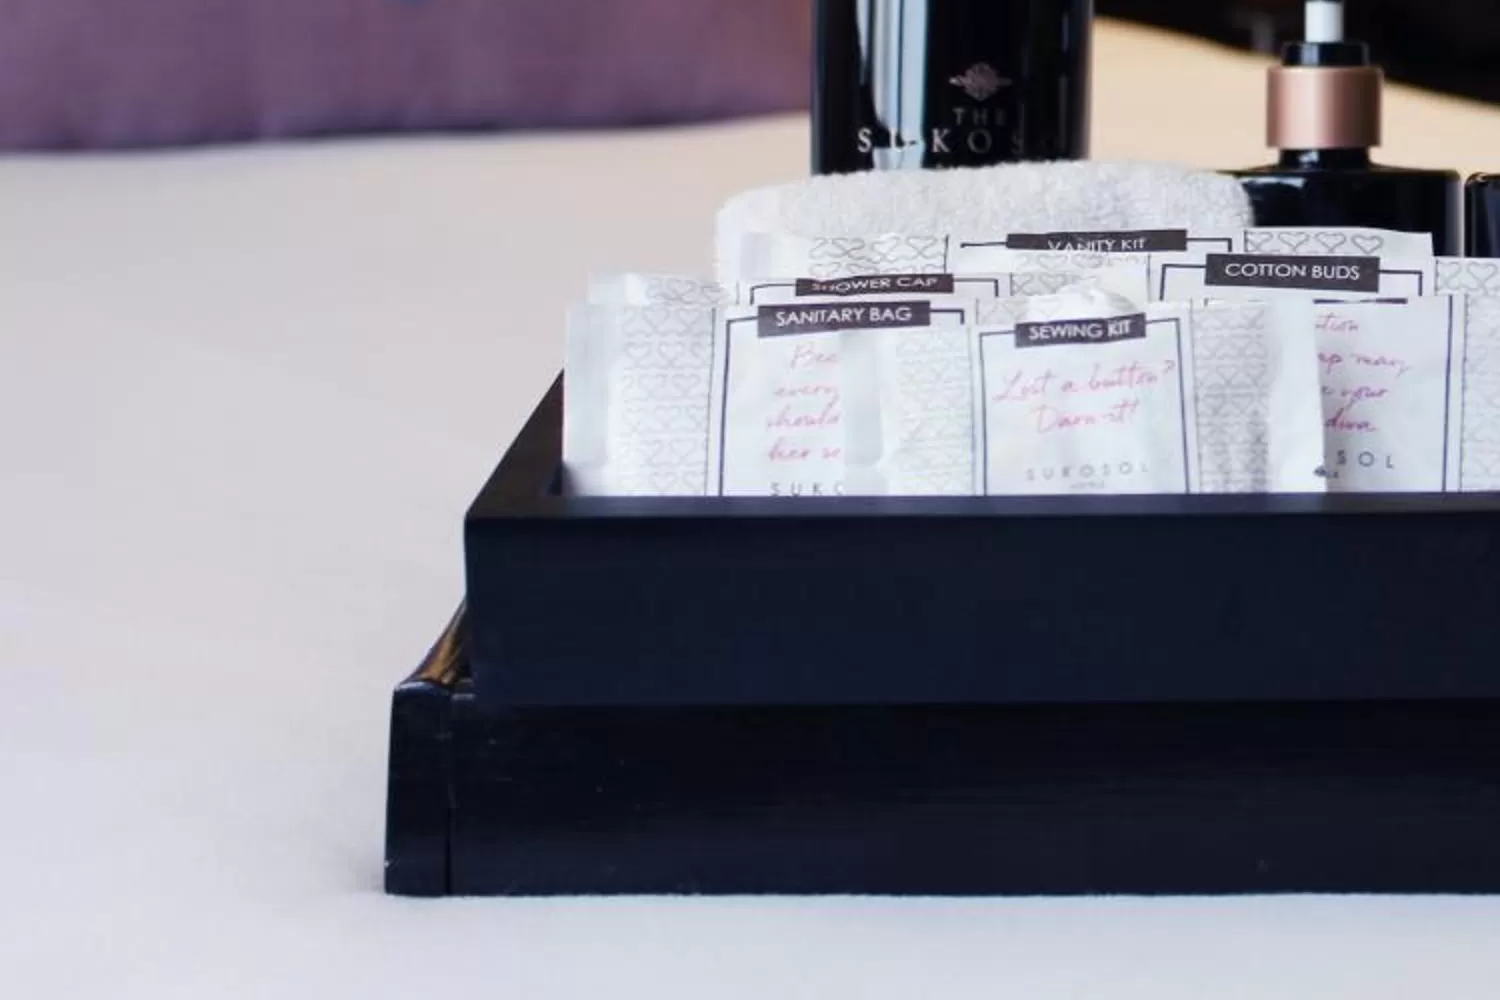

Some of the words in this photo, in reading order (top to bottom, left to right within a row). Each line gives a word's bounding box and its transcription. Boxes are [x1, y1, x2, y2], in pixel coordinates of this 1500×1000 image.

[1047, 238, 1117, 251] VANITY
[1121, 236, 1148, 251] KIT
[1224, 262, 1307, 278] COTTON
[1311, 264, 1361, 281] BUDS
[896, 276, 939, 289] CAP
[775, 308, 865, 327] SANITARY
[869, 305, 913, 323] BAG
[1028, 321, 1103, 341] SEWING
[1107, 319, 1133, 337] KIT
[1060, 379, 1079, 394] a
[1025, 461, 1149, 482] SUKOSOL
